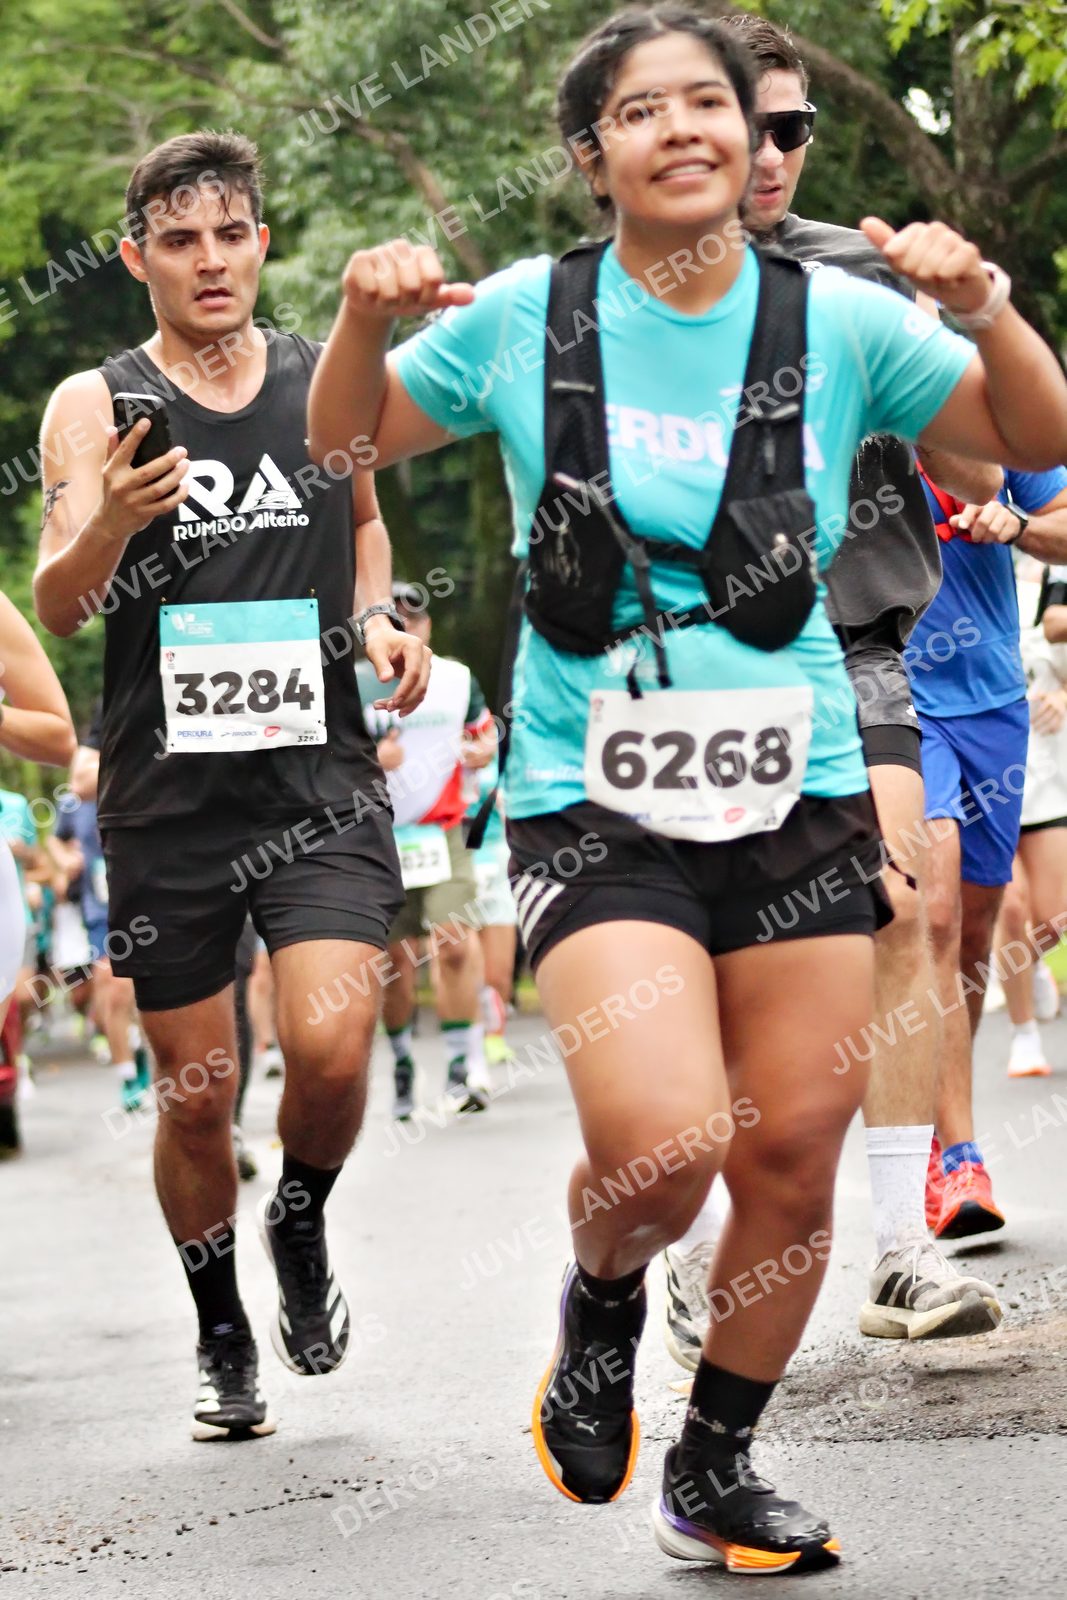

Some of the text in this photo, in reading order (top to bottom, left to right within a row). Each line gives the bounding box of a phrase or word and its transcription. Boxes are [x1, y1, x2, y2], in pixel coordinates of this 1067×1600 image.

[248, 509, 310, 531] Alteño
[174, 667, 315, 716] 3284
[601, 726, 793, 790] 6268
